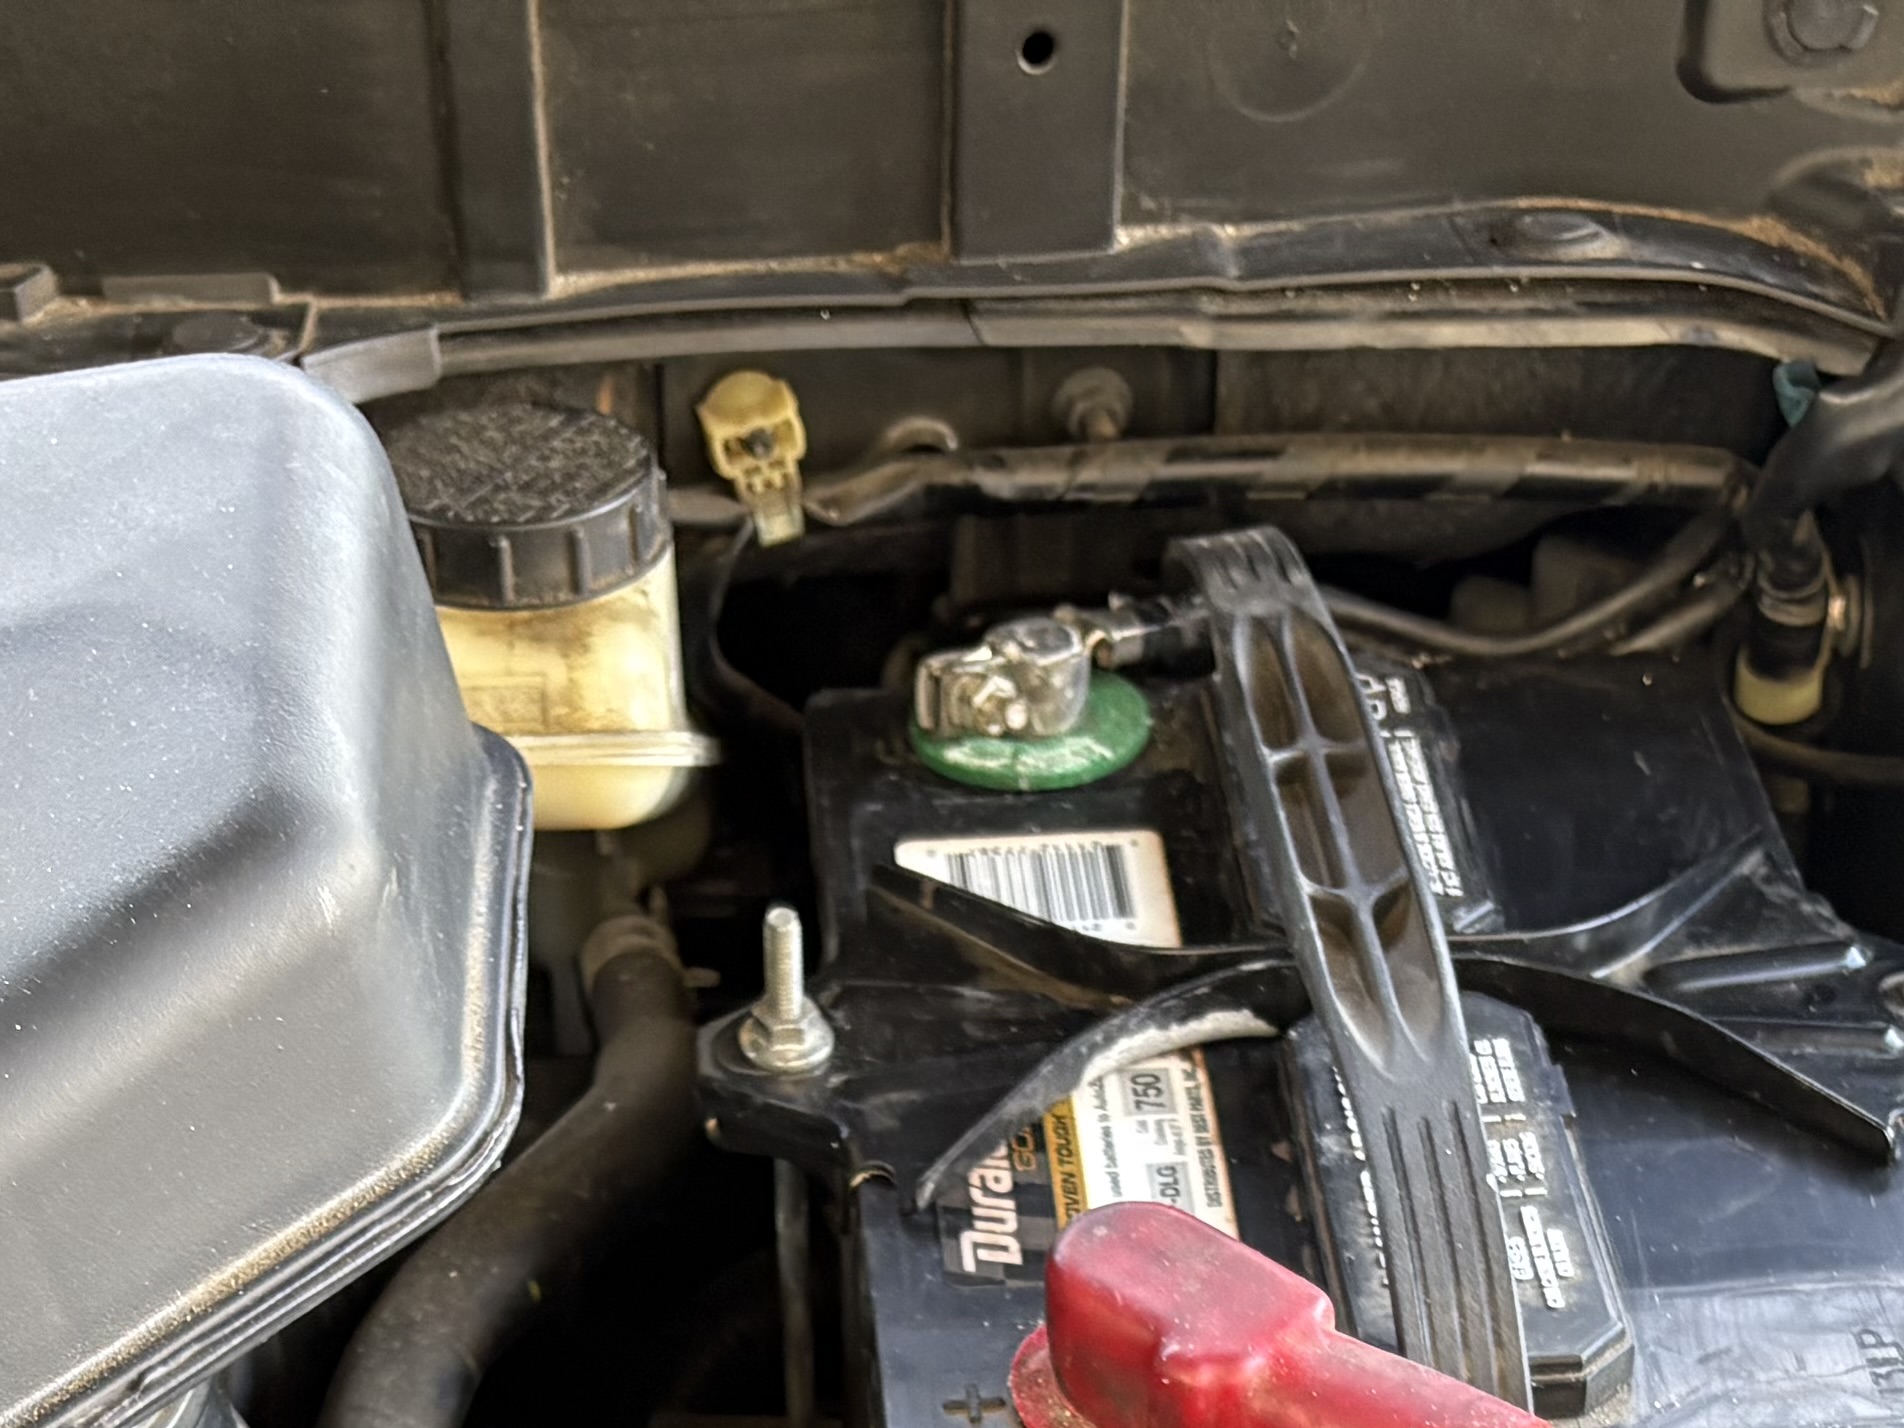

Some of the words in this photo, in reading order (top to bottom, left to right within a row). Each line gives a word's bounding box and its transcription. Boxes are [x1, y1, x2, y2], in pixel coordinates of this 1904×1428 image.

[1131, 1073, 1167, 1110] 750
[1012, 1126, 1037, 1171] GO
[1055, 1113, 1073, 1168] TOUGH
[1060, 1171, 1081, 1219] OVEN
[1156, 1165, 1181, 1204] -DLG
[1197, 1148, 1223, 1208] DISTRIBUTED
